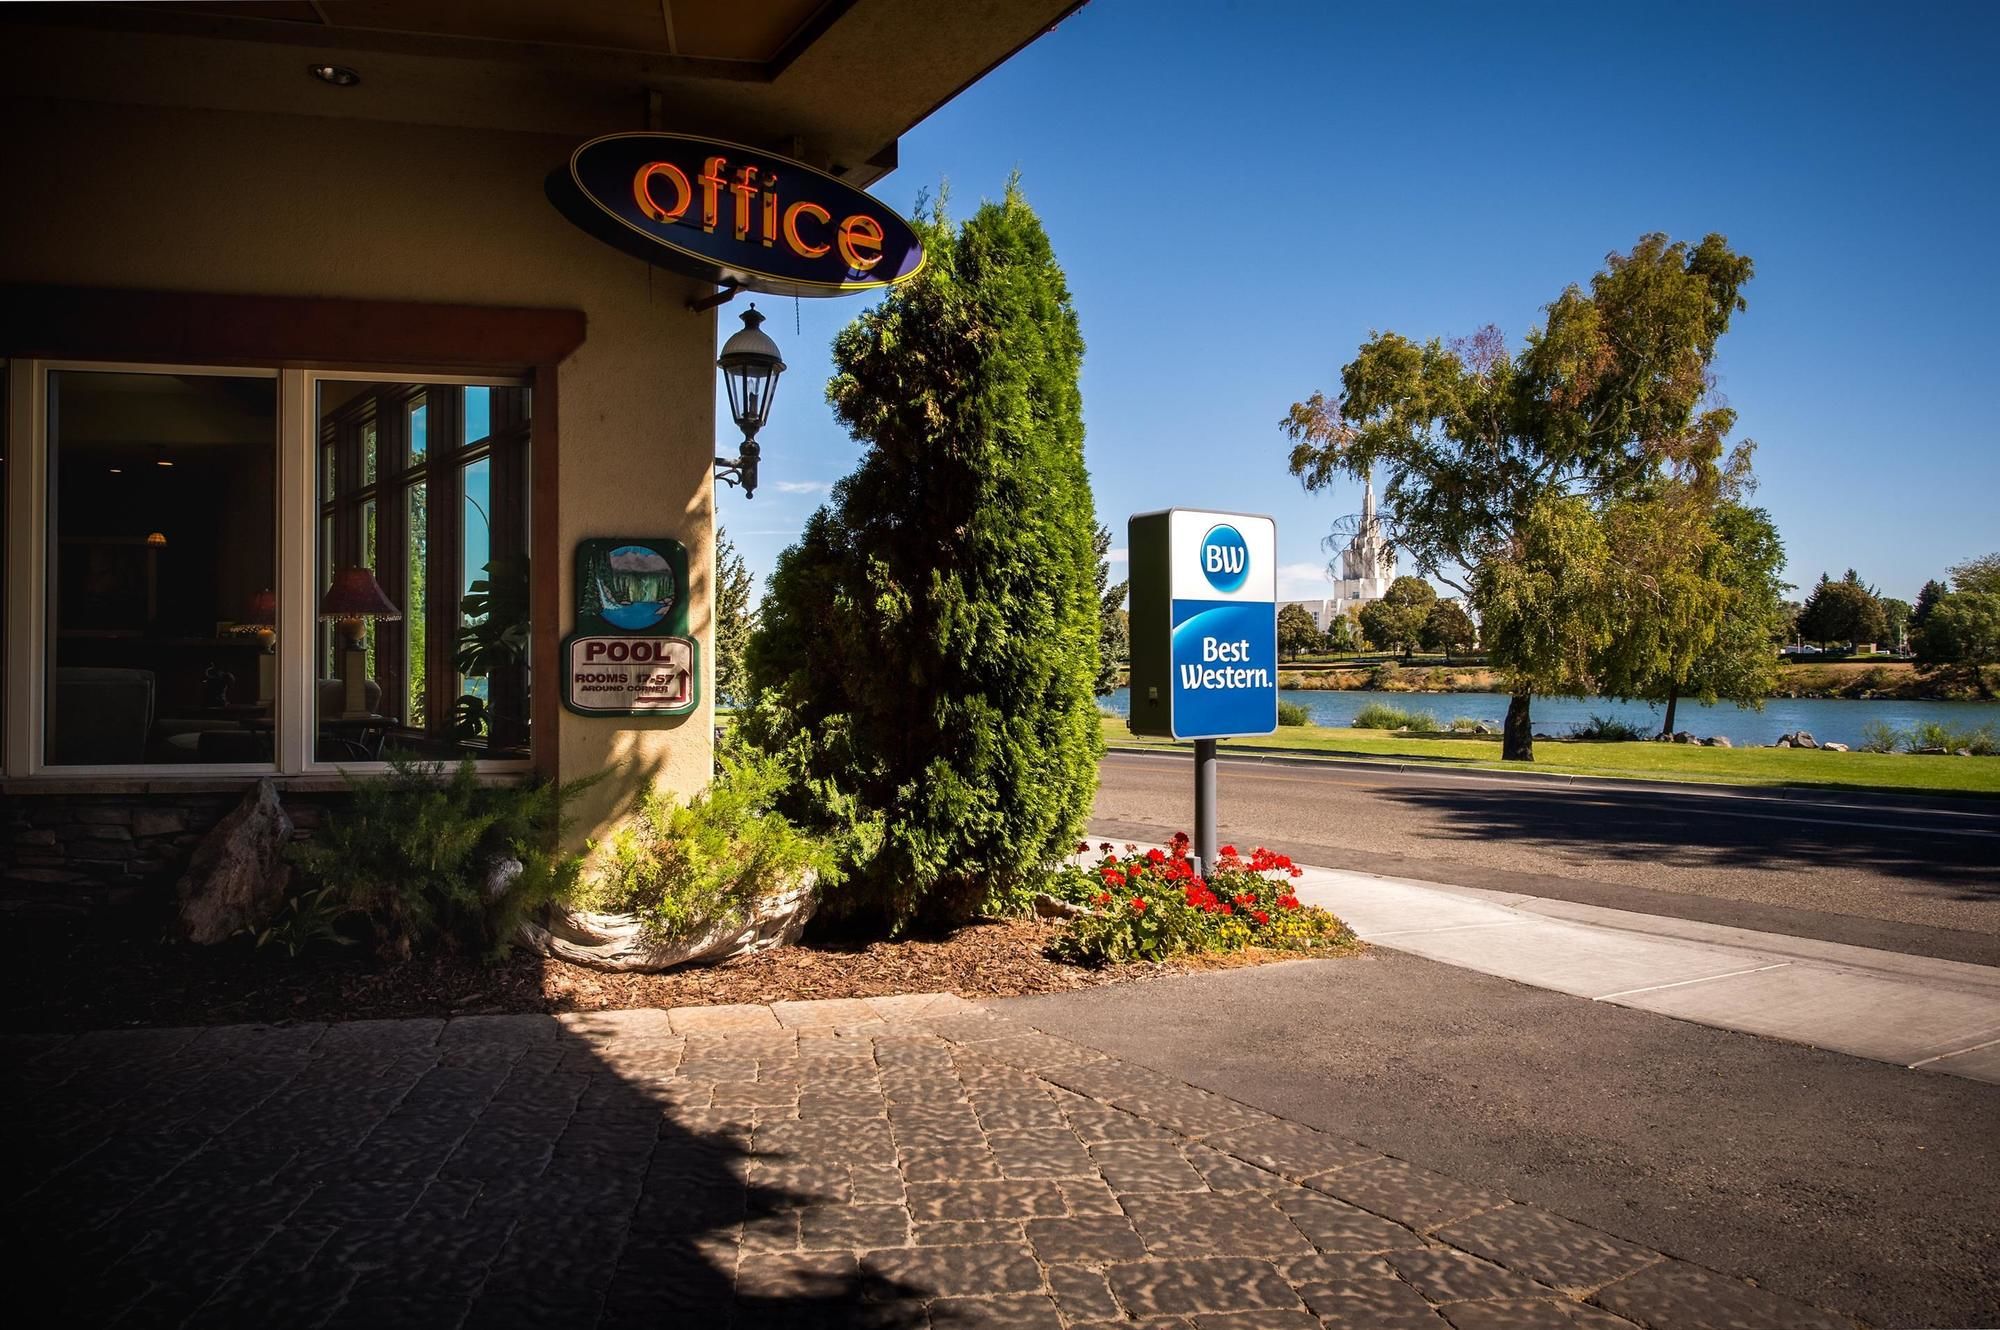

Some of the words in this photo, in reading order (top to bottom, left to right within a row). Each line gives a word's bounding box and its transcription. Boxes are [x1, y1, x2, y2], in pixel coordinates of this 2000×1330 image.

[1206, 544, 1245, 574] BW
[585, 641, 671, 662] POOL
[1203, 637, 1250, 662] Best
[575, 673, 628, 684] ROOMS
[637, 673, 675, 686] 17-57
[581, 684, 624, 692] AROUND
[627, 684, 669, 694] CORNER
